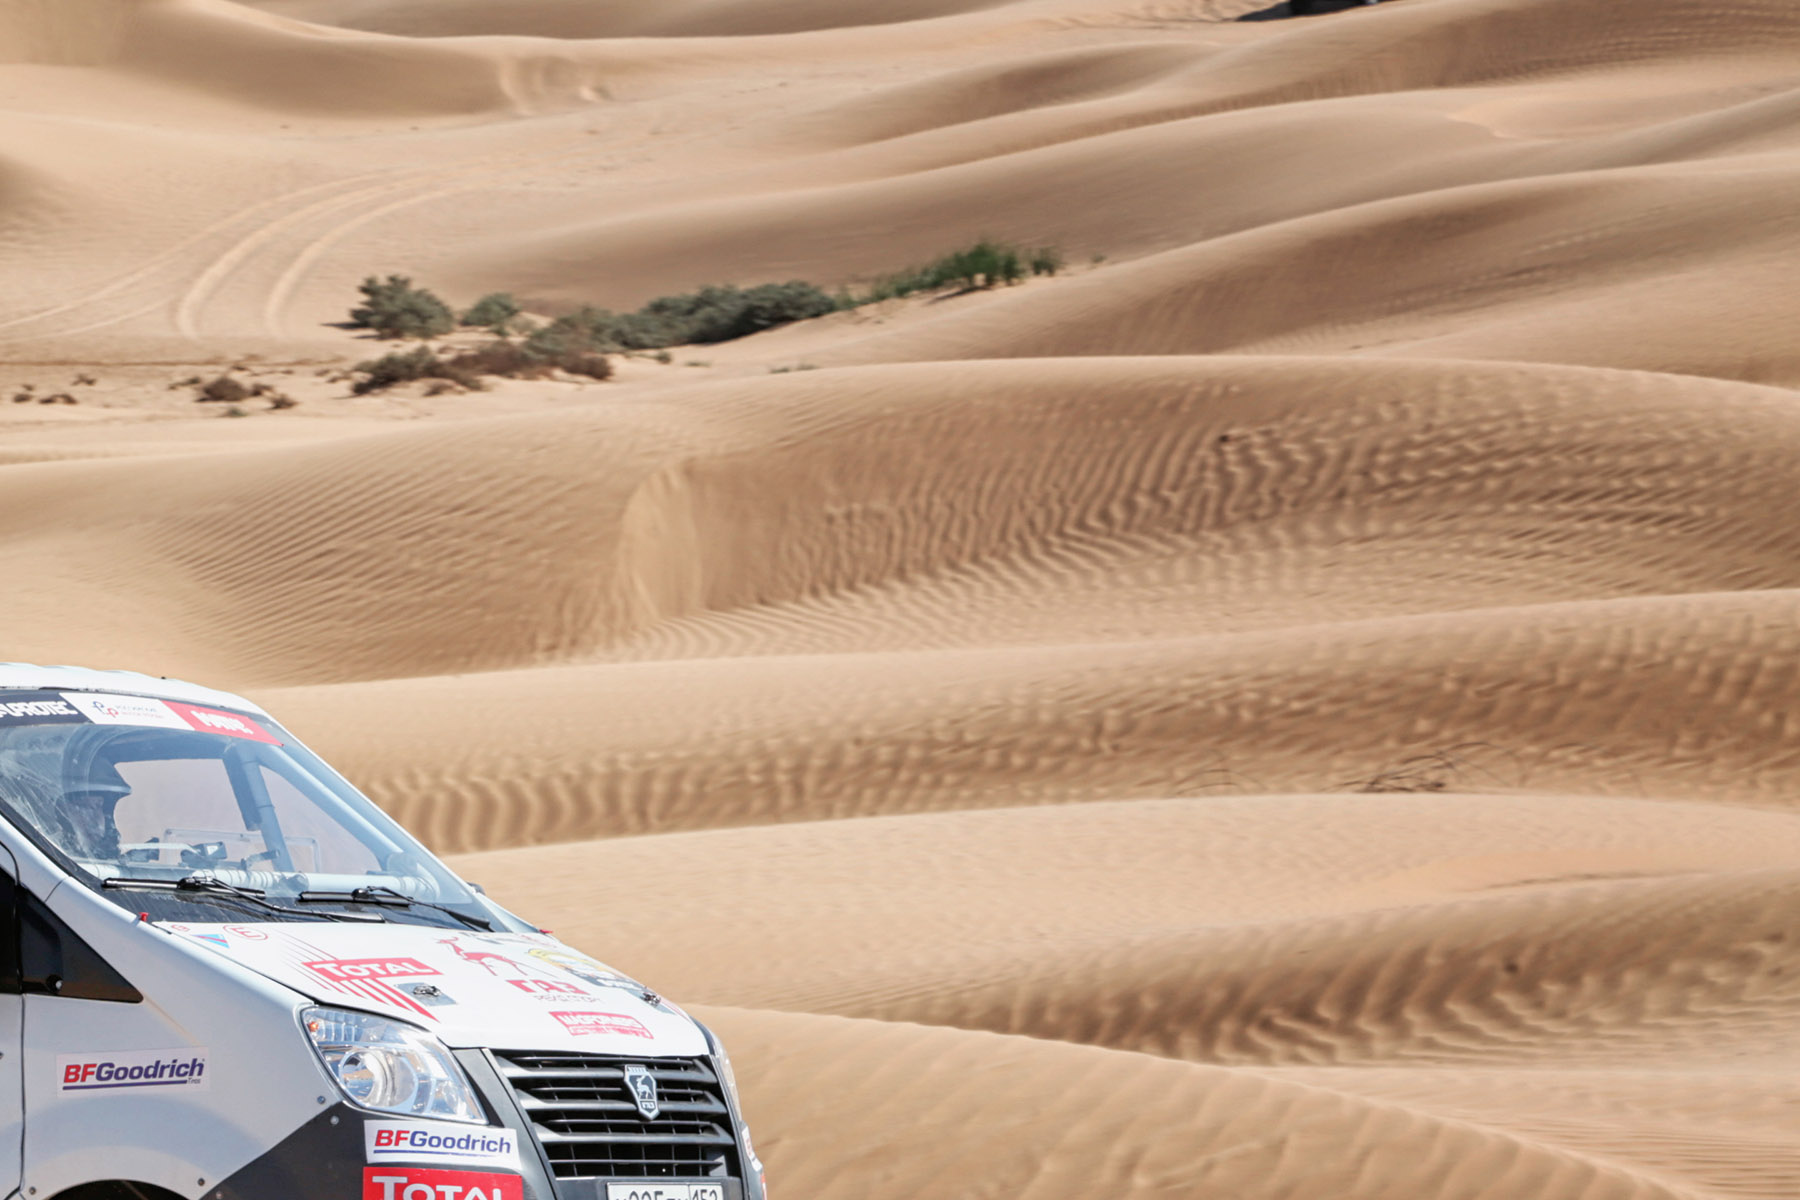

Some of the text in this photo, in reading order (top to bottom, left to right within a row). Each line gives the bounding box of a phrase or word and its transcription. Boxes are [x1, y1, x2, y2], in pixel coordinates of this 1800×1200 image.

[311, 960, 435, 979] TOTAL
[506, 979, 591, 995] ГАЗ
[63, 1058, 204, 1084] BFGoodrich
[374, 1129, 511, 1154] BFGoodrich
